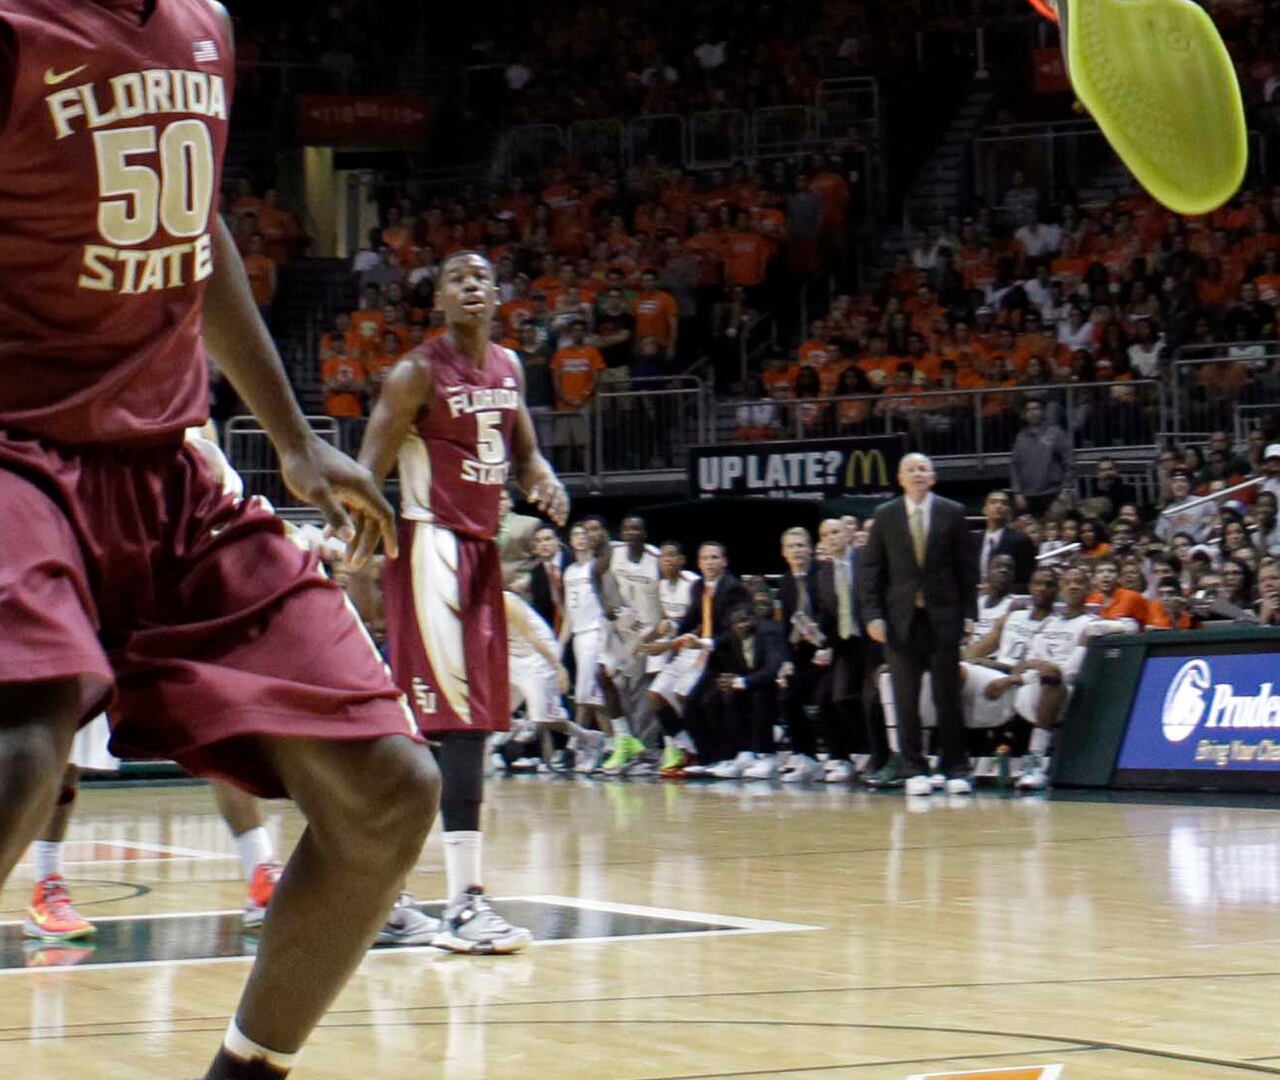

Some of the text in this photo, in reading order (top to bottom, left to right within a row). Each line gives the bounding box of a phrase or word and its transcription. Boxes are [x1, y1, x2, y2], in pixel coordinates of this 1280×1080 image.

[45, 69, 227, 140] FLORIDA
[92, 119, 214, 246] 50
[78, 234, 214, 294] STATE
[475, 411, 505, 464] 5
[698, 456, 743, 490] UP
[746, 450, 843, 488] LATE?
[1194, 740, 1230, 766] Bring
[1230, 740, 1257, 761] Your
